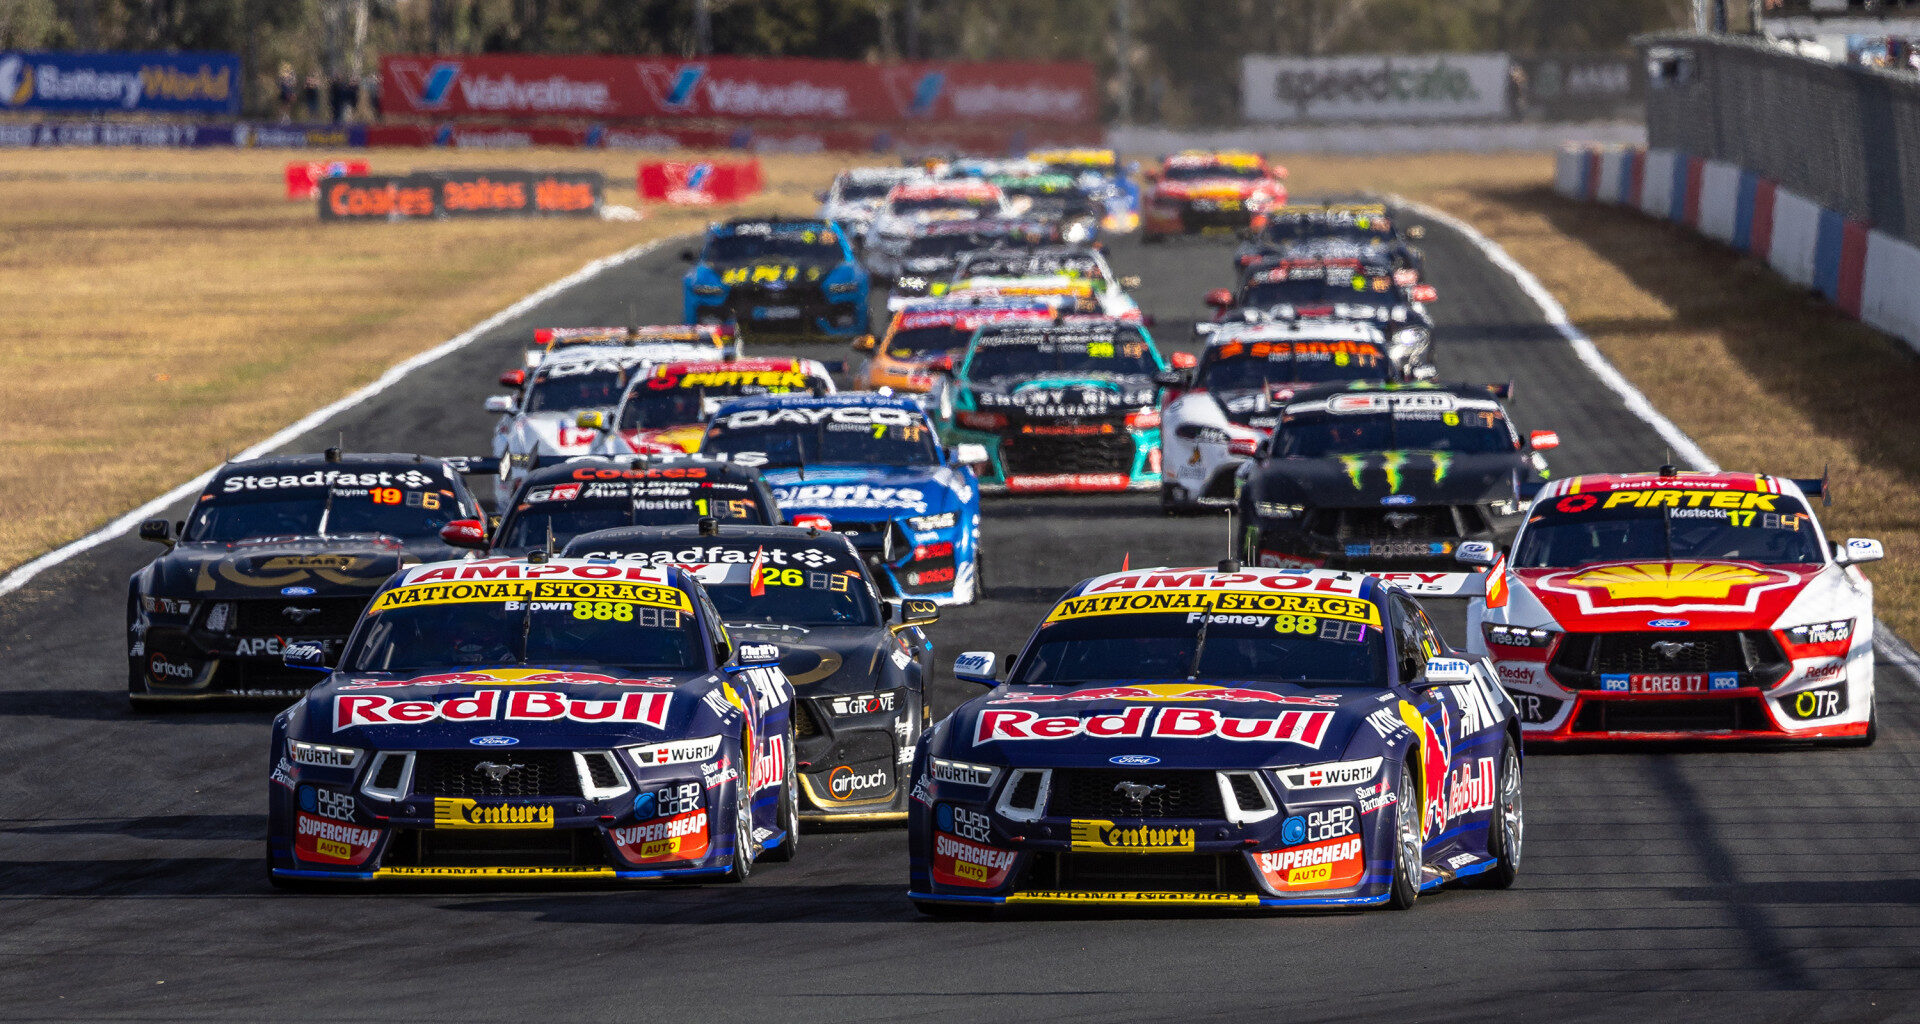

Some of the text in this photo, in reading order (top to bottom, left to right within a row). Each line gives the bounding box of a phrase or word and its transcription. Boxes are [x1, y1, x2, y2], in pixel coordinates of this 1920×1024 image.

[460, 74, 609, 109] Valvoline
[329, 184, 433, 215] Coates
[680, 370, 807, 388] PIRTEK
[727, 405, 911, 430] DAYCO
[871, 424, 889, 439] 7
[223, 469, 393, 493] Steadfast
[370, 487, 402, 505] 19
[1602, 490, 1780, 510] PIRTEK
[632, 500, 693, 511] Mostert
[695, 499, 709, 516] 1
[1670, 507, 1727, 519] Kostecki
[1727, 510, 1757, 527] 17
[409, 563, 663, 584] AMPOL
[763, 566, 805, 588] 26
[1090, 573, 1353, 594] AMPOL
[382, 581, 679, 607] NATIONAL STORAGE
[1060, 591, 1366, 618] NATIONAL STORAGE
[505, 600, 573, 612] Brown
[572, 600, 635, 622] 888
[1186, 612, 1270, 628] Feeney
[1274, 614, 1318, 636] 88
[740, 644, 779, 657] Thrifty
[1427, 661, 1470, 675] Thrifty
[1499, 665, 1535, 684] Reddy
[1806, 663, 1843, 678] Reddy
[1641, 675, 1680, 692] CRE8
[334, 690, 674, 733] Red Bull
[849, 695, 895, 715] GROVE
[1795, 690, 1840, 718] OTR
[973, 706, 1336, 750] Red Bull
[296, 749, 340, 765] WÜRTH
[671, 744, 715, 761] WÜRTH
[832, 767, 887, 793] airtouch
[936, 765, 979, 783] WÜRTH
[1325, 764, 1373, 784] WÜRTH
[317, 788, 356, 810] QUAD
[657, 782, 700, 802] QUAD
[1359, 792, 1397, 814] Partners
[317, 802, 356, 823] LOCK
[435, 798, 554, 829] Century
[657, 796, 700, 818] LOCK
[954, 806, 991, 829] QUAD
[1308, 805, 1354, 827] QUAD
[298, 816, 379, 849] SUPERCHEAP
[615, 813, 707, 847] SUPERCHEAP
[954, 821, 991, 843] LOCK
[1071, 819, 1195, 852] Century
[1308, 819, 1354, 842] LOCK
[320, 841, 348, 855] AUTO
[645, 840, 677, 855] AUTO
[937, 835, 1015, 871] SUPERCHEAP
[1261, 838, 1362, 873] SUPERCHEAP
[958, 864, 984, 879] AUTO
[1292, 867, 1328, 882] AUTO
